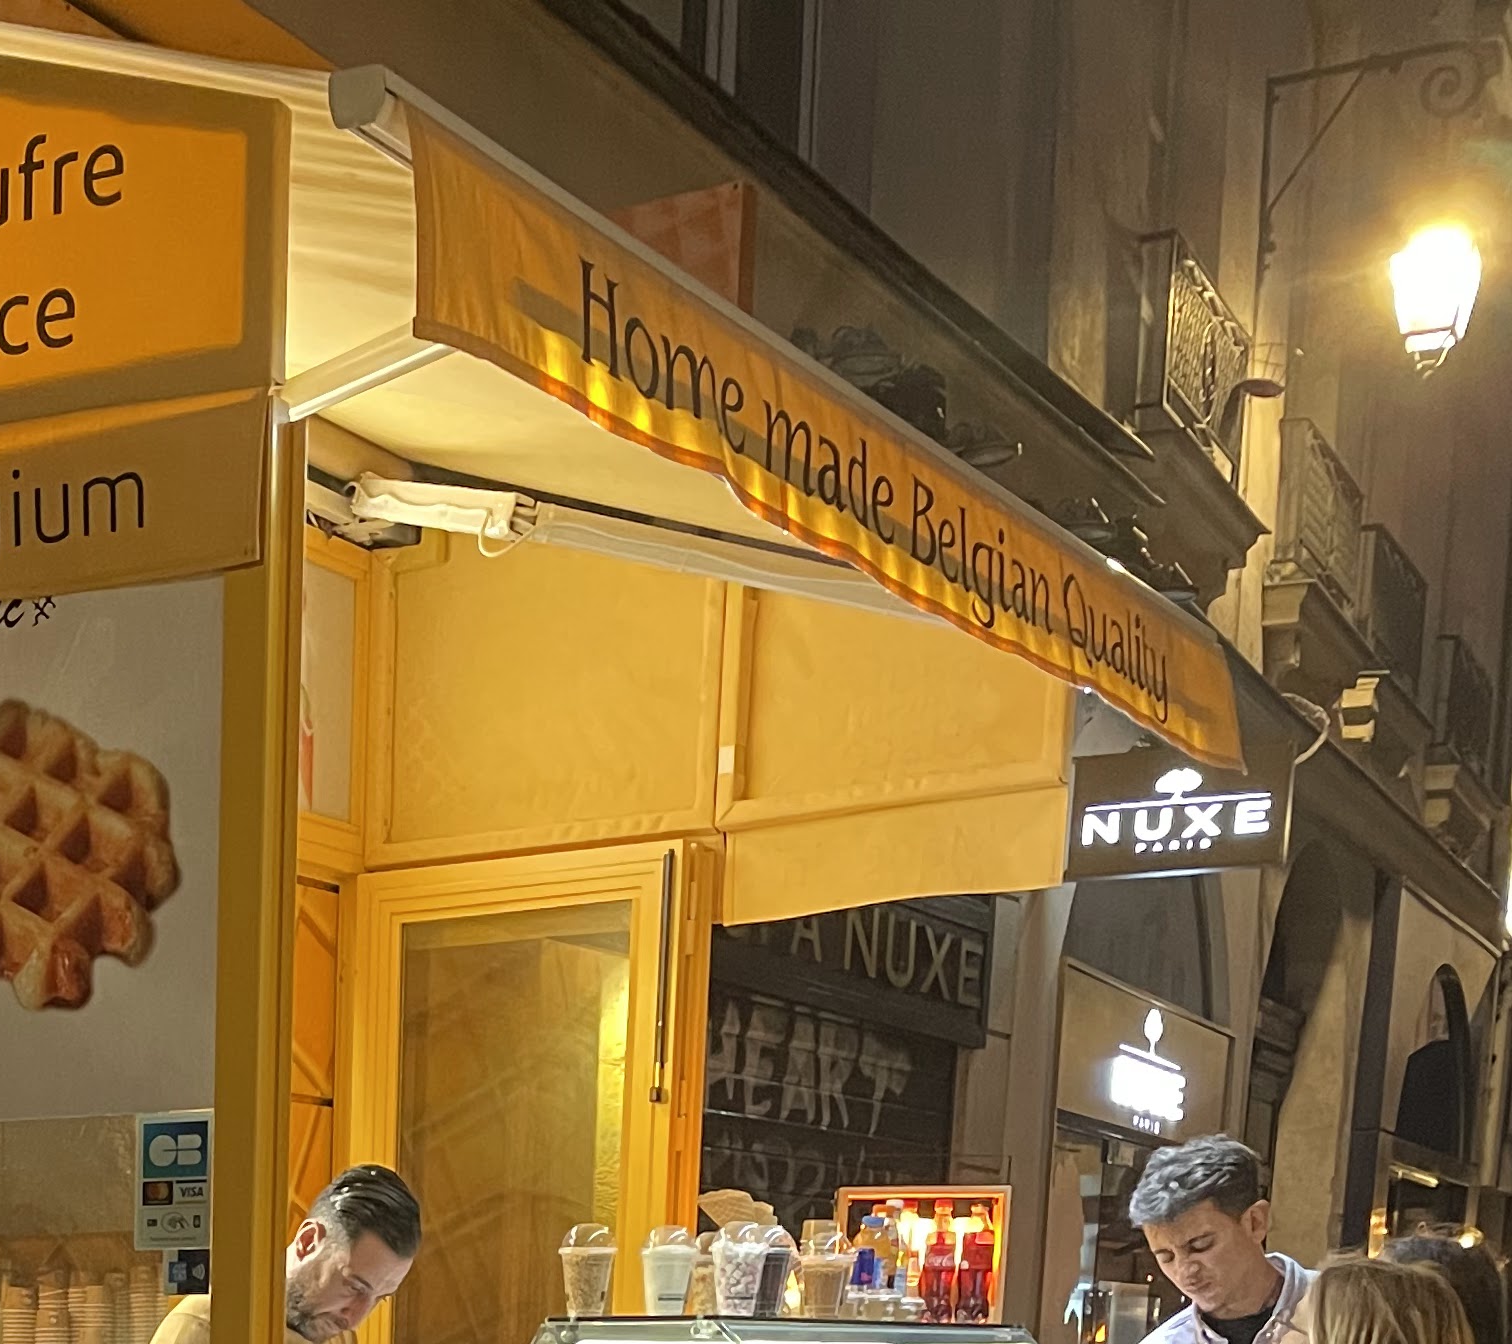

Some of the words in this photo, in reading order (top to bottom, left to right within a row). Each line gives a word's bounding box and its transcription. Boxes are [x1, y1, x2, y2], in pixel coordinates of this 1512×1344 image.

[579, 256, 745, 455] Home
[763, 400, 895, 545] made
[909, 473, 1055, 635] Belgian
[1063, 573, 1168, 724] Quality
[1081, 799, 1272, 847] NUXE
[843, 908, 985, 1009] NUXE
[148, 1134, 203, 1168] CB
[178, 1186, 204, 1198] VISA
